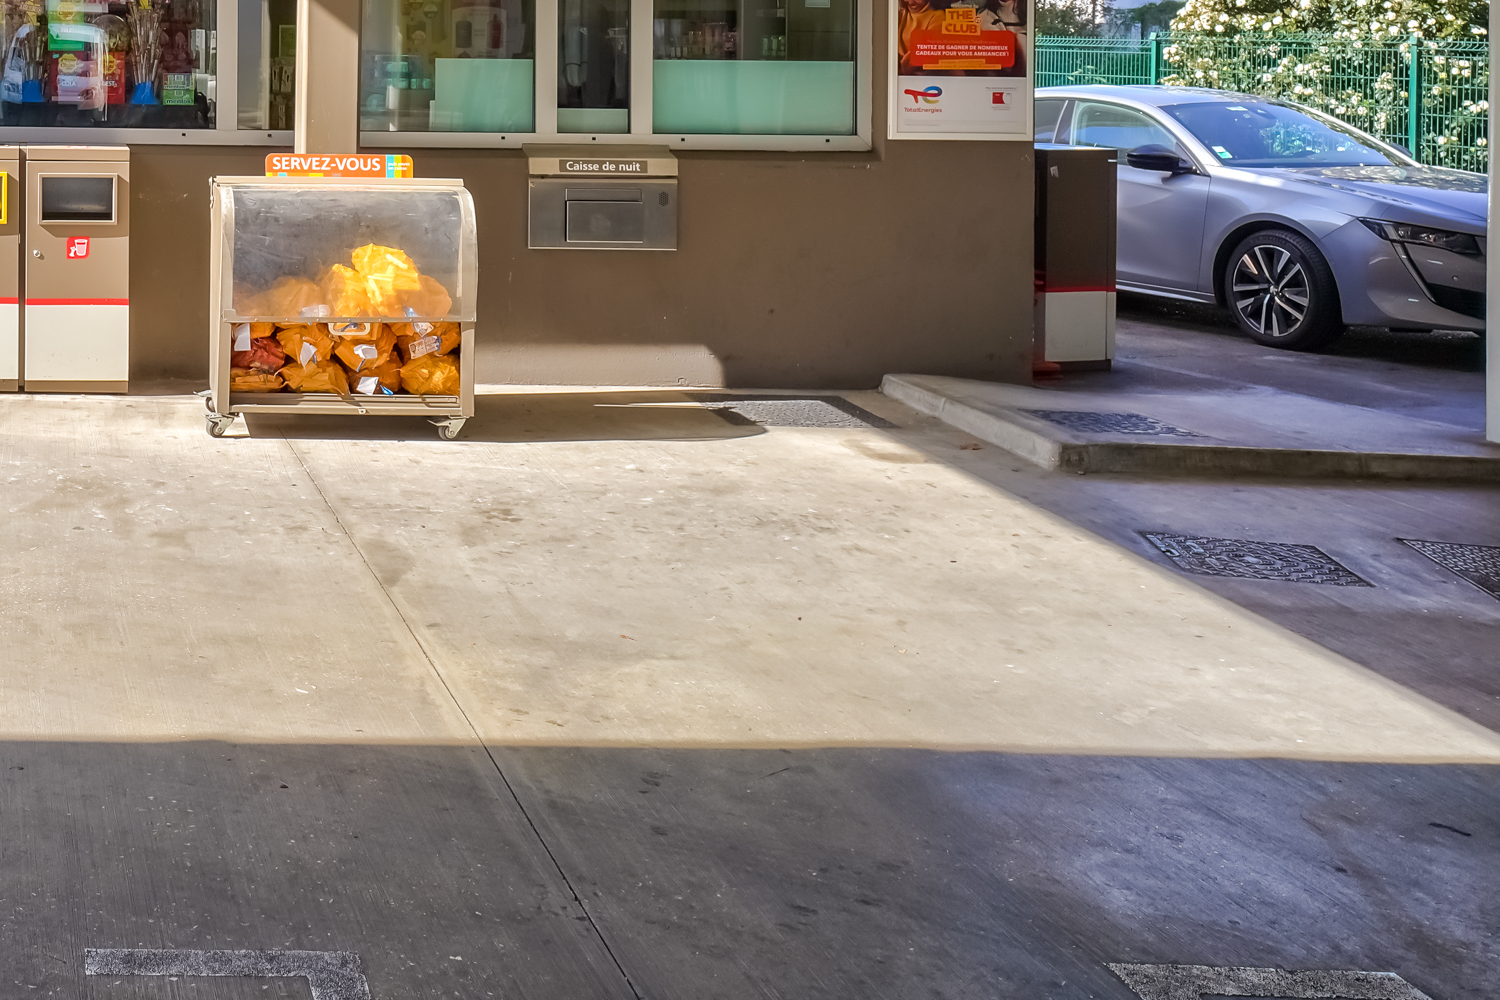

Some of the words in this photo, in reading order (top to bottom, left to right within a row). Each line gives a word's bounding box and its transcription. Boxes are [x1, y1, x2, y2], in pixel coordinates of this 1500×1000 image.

[948, 10, 973, 20] THE
[945, 23, 977, 33] CLUB
[272, 157, 380, 171] SERVEZ-VOUS
[566, 162, 599, 171] Caisse
[602, 162, 616, 171] de
[619, 162, 641, 171] nuit
